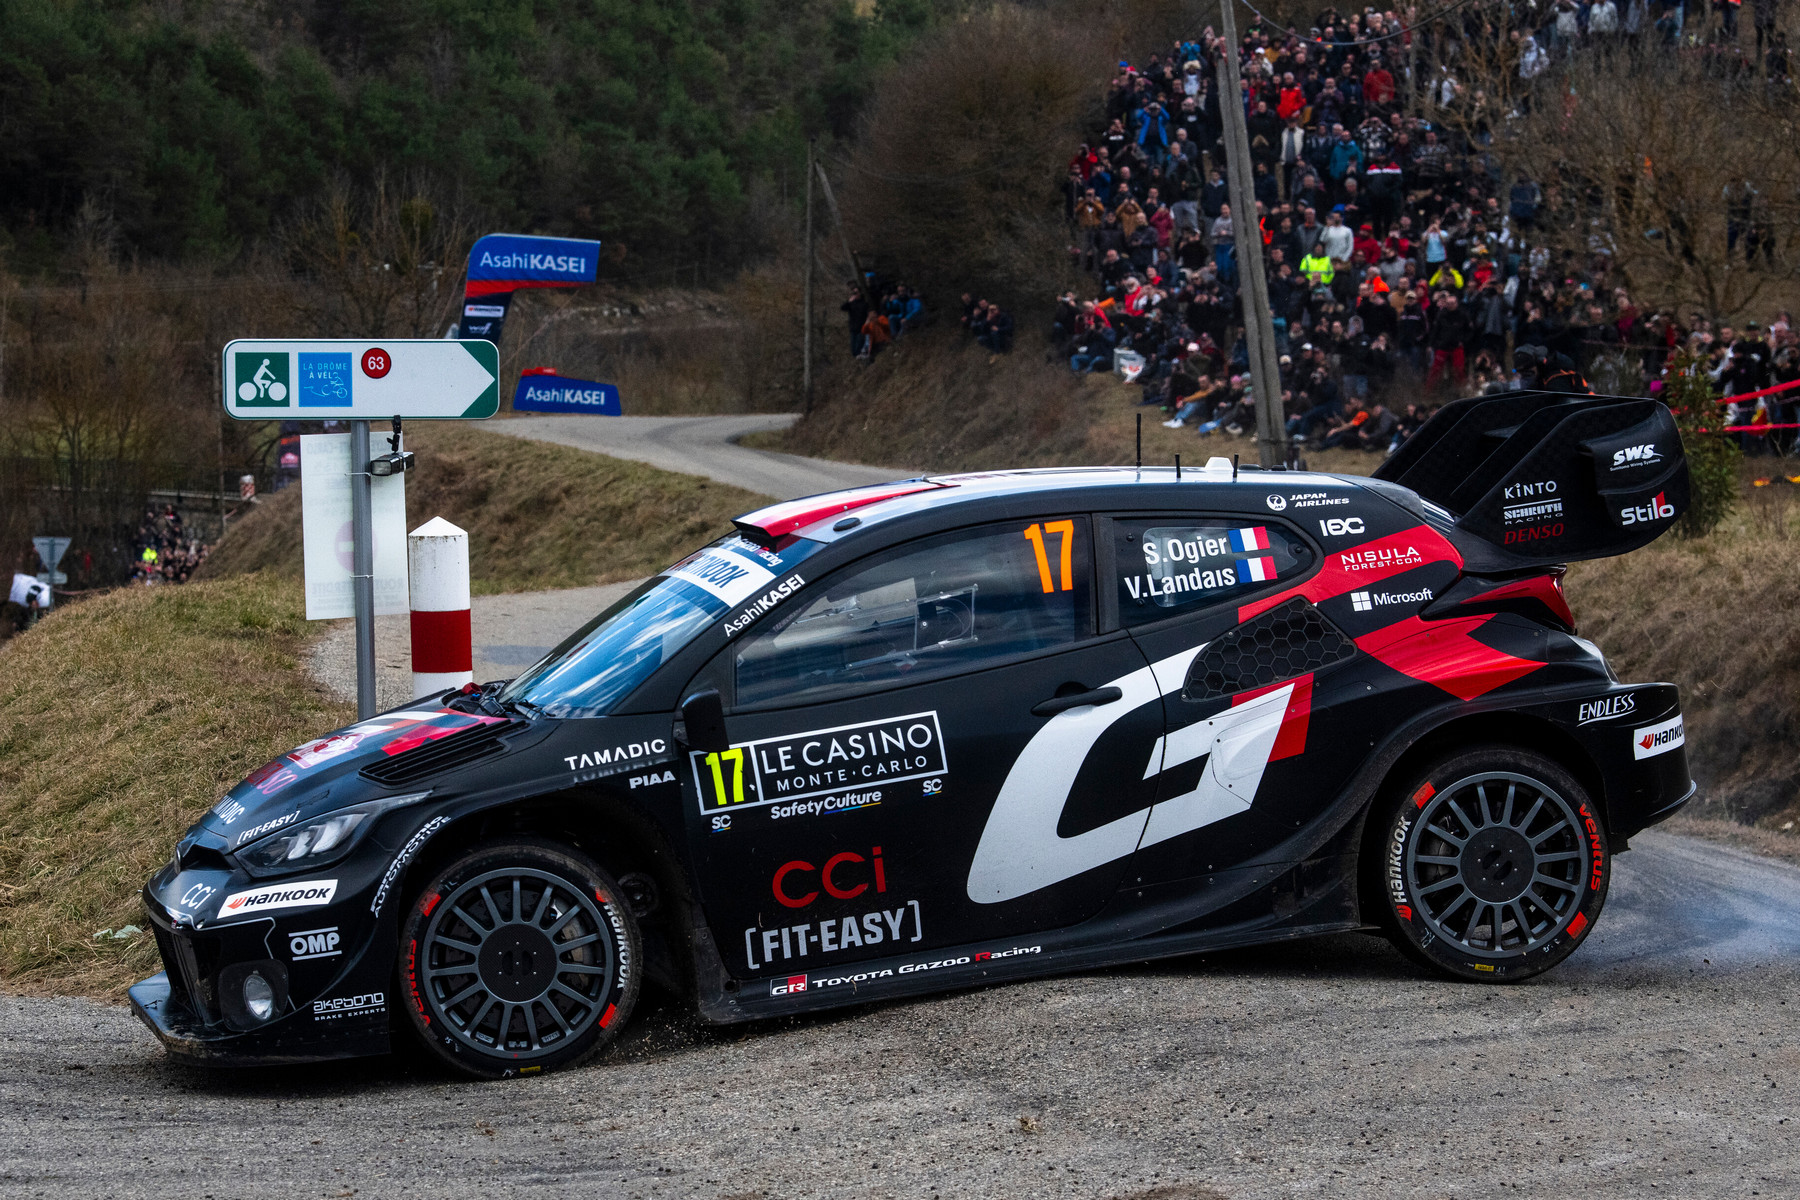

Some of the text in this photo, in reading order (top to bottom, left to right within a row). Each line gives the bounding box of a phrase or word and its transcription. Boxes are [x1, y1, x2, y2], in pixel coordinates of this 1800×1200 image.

[479, 250, 586, 275] AsahiKASEI
[303, 362, 314, 371] LA
[368, 356, 385, 371] 63
[526, 386, 605, 406] AsahiKASEI
[1613, 444, 1664, 466] SWS
[1290, 492, 1327, 503] JAPAN
[1295, 498, 1350, 509] AIRLINES
[1504, 502, 1563, 520] SCHROTH
[1505, 512, 1563, 525] RACING
[1621, 492, 1675, 526] Stilo
[1504, 523, 1564, 544] DENSO
[1023, 519, 1075, 594] 17
[1341, 545, 1420, 564] NISULA
[1124, 565, 1236, 600] V.Landais
[723, 574, 806, 638] AsahiKASEI
[1373, 587, 1434, 606] Microsoft
[1578, 693, 1635, 721] ENDLESS
[564, 738, 667, 771] TAMADIC
[760, 722, 933, 775] LE CASINO
[629, 770, 676, 790] PIAA
[705, 747, 745, 807] 17
[922, 778, 943, 794] SC
[770, 788, 883, 820] SafetyCulture
[711, 814, 732, 830] SC
[374, 815, 452, 919] AUTOMOTIVE
[290, 932, 340, 955] OMP
[771, 945, 1042, 995] GR TOYOTA GAZOO Racing
[314, 1007, 386, 1021] BRAKE EXPERTS
